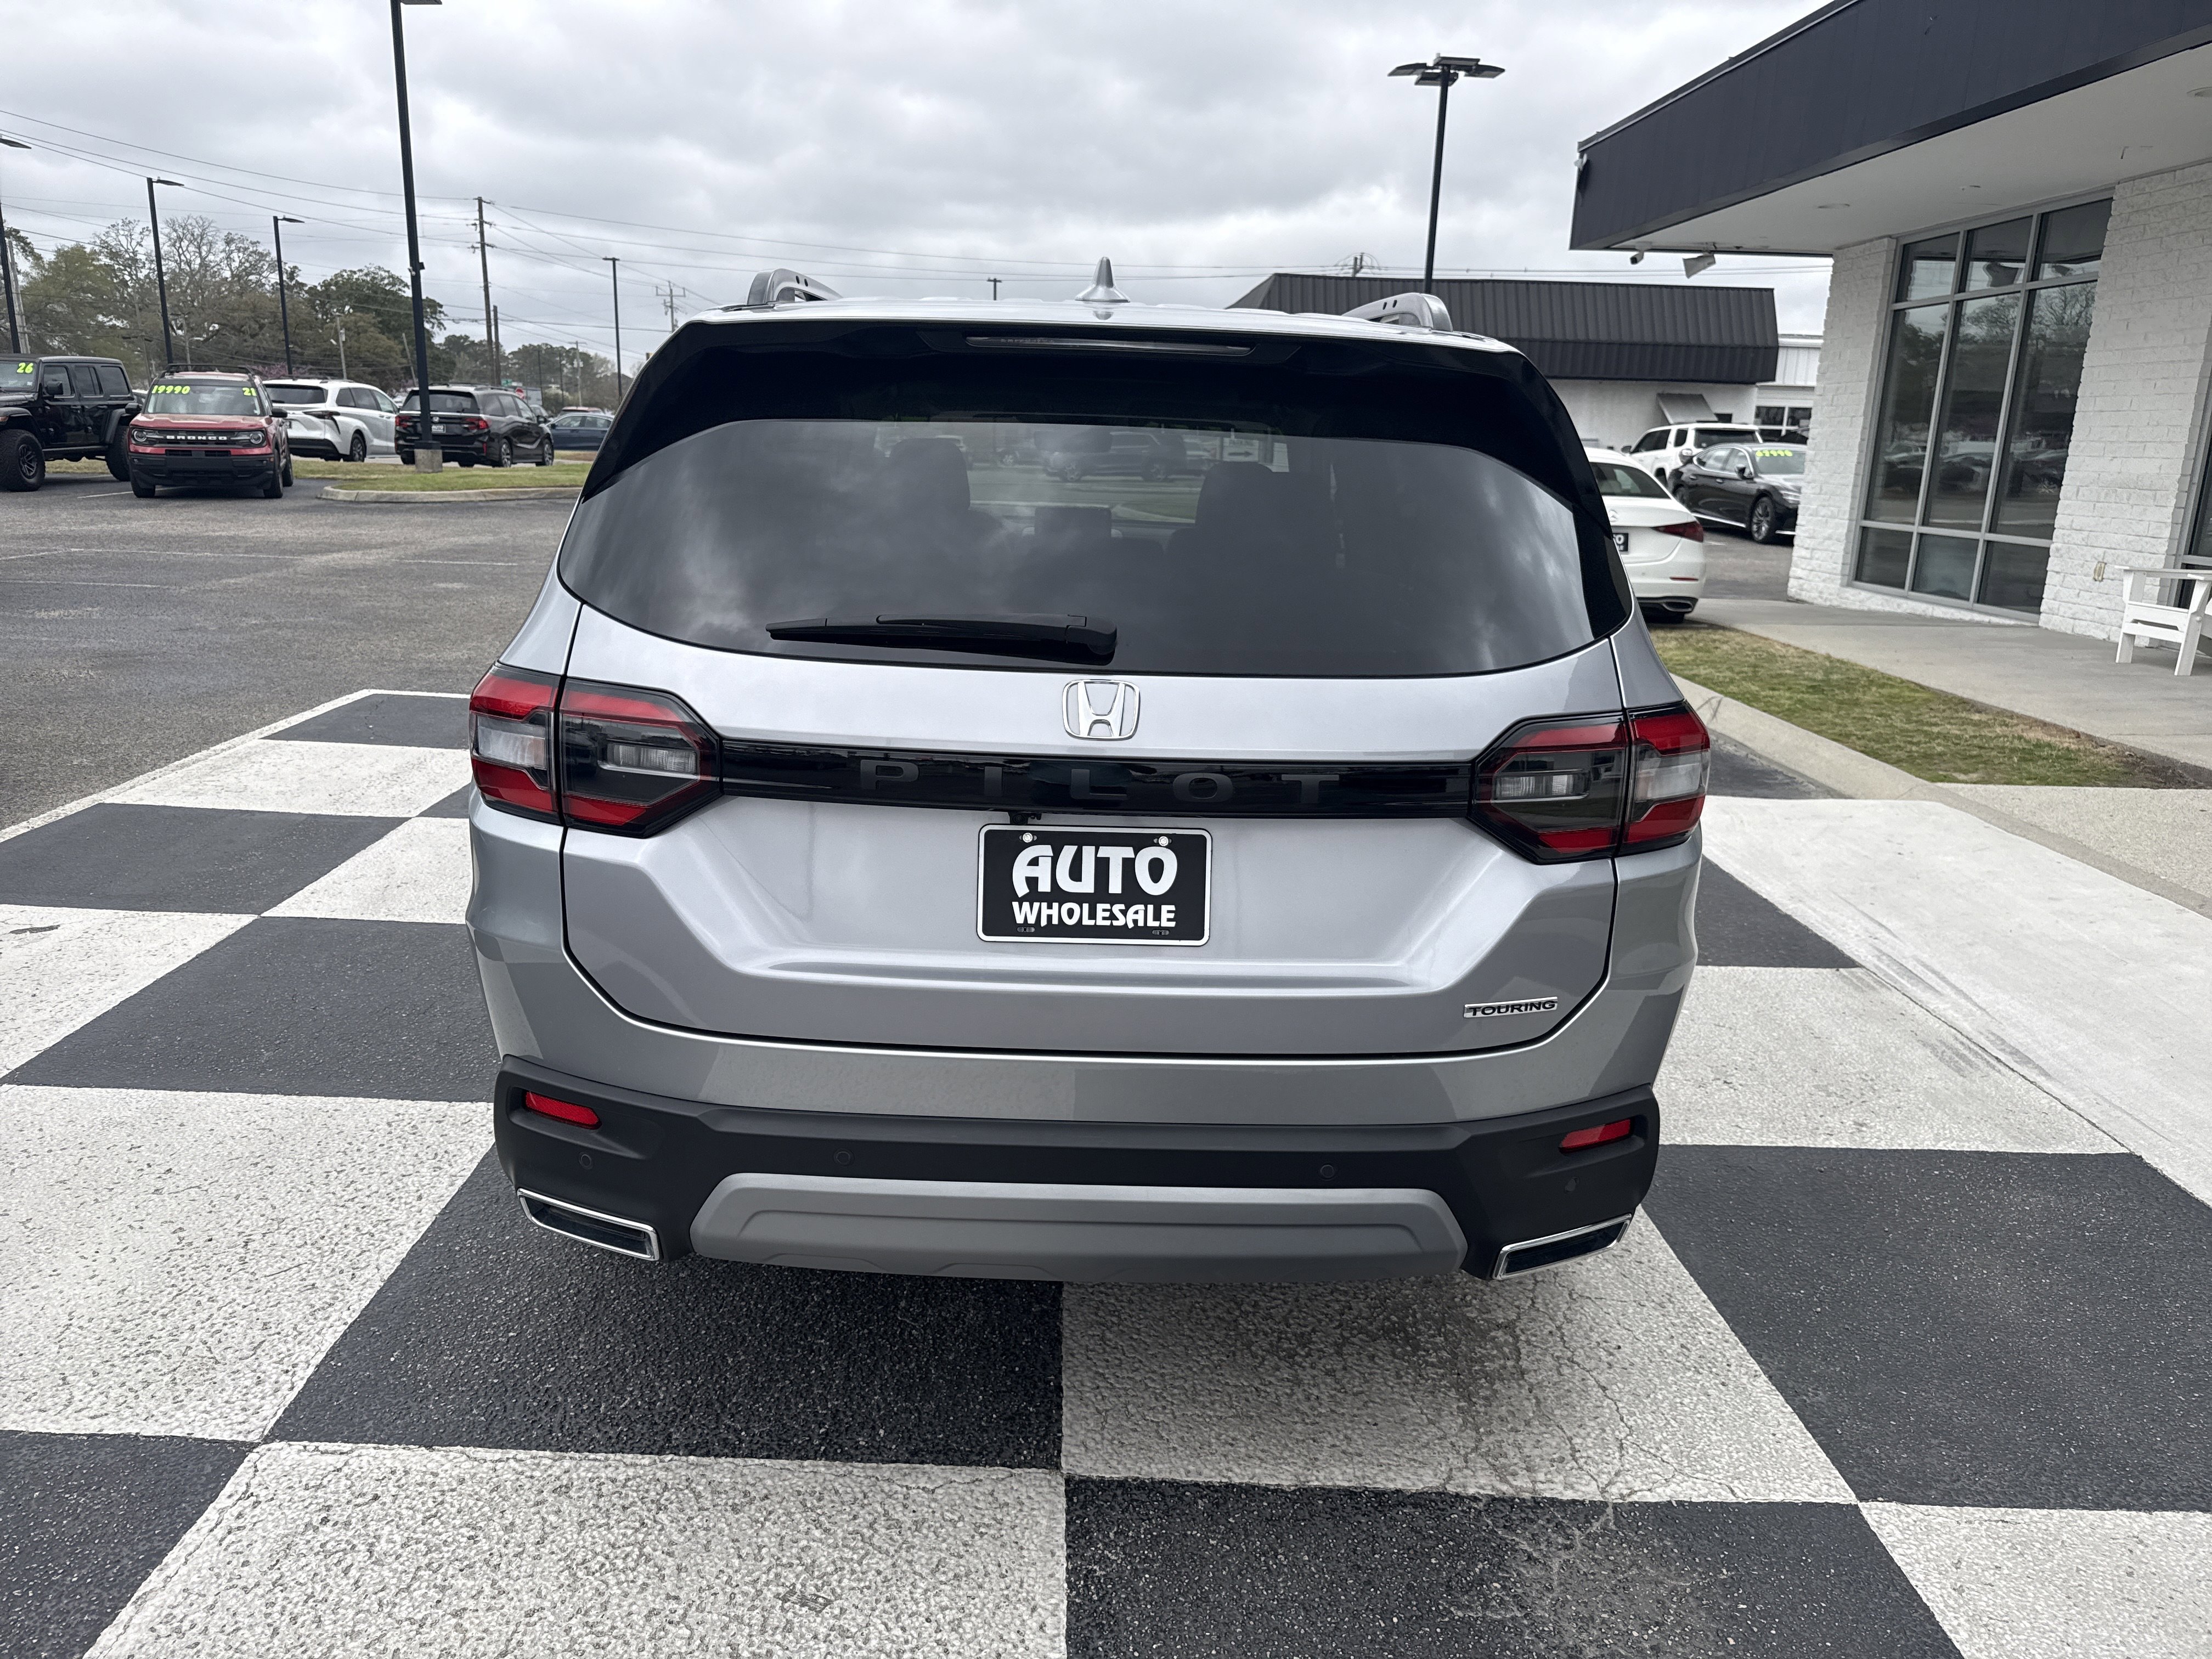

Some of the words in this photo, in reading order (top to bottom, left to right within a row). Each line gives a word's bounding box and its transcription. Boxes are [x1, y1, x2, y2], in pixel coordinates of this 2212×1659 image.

[16, 362, 33, 374] 26
[151, 385, 190, 394] 19990
[242, 387, 257, 396] 21
[859, 759, 1340, 804] PILOT
[1012, 844, 1178, 898] AUTO
[1012, 901, 1176, 929] WHOLESALE
[1469, 1000, 1556, 1017] TOURING
